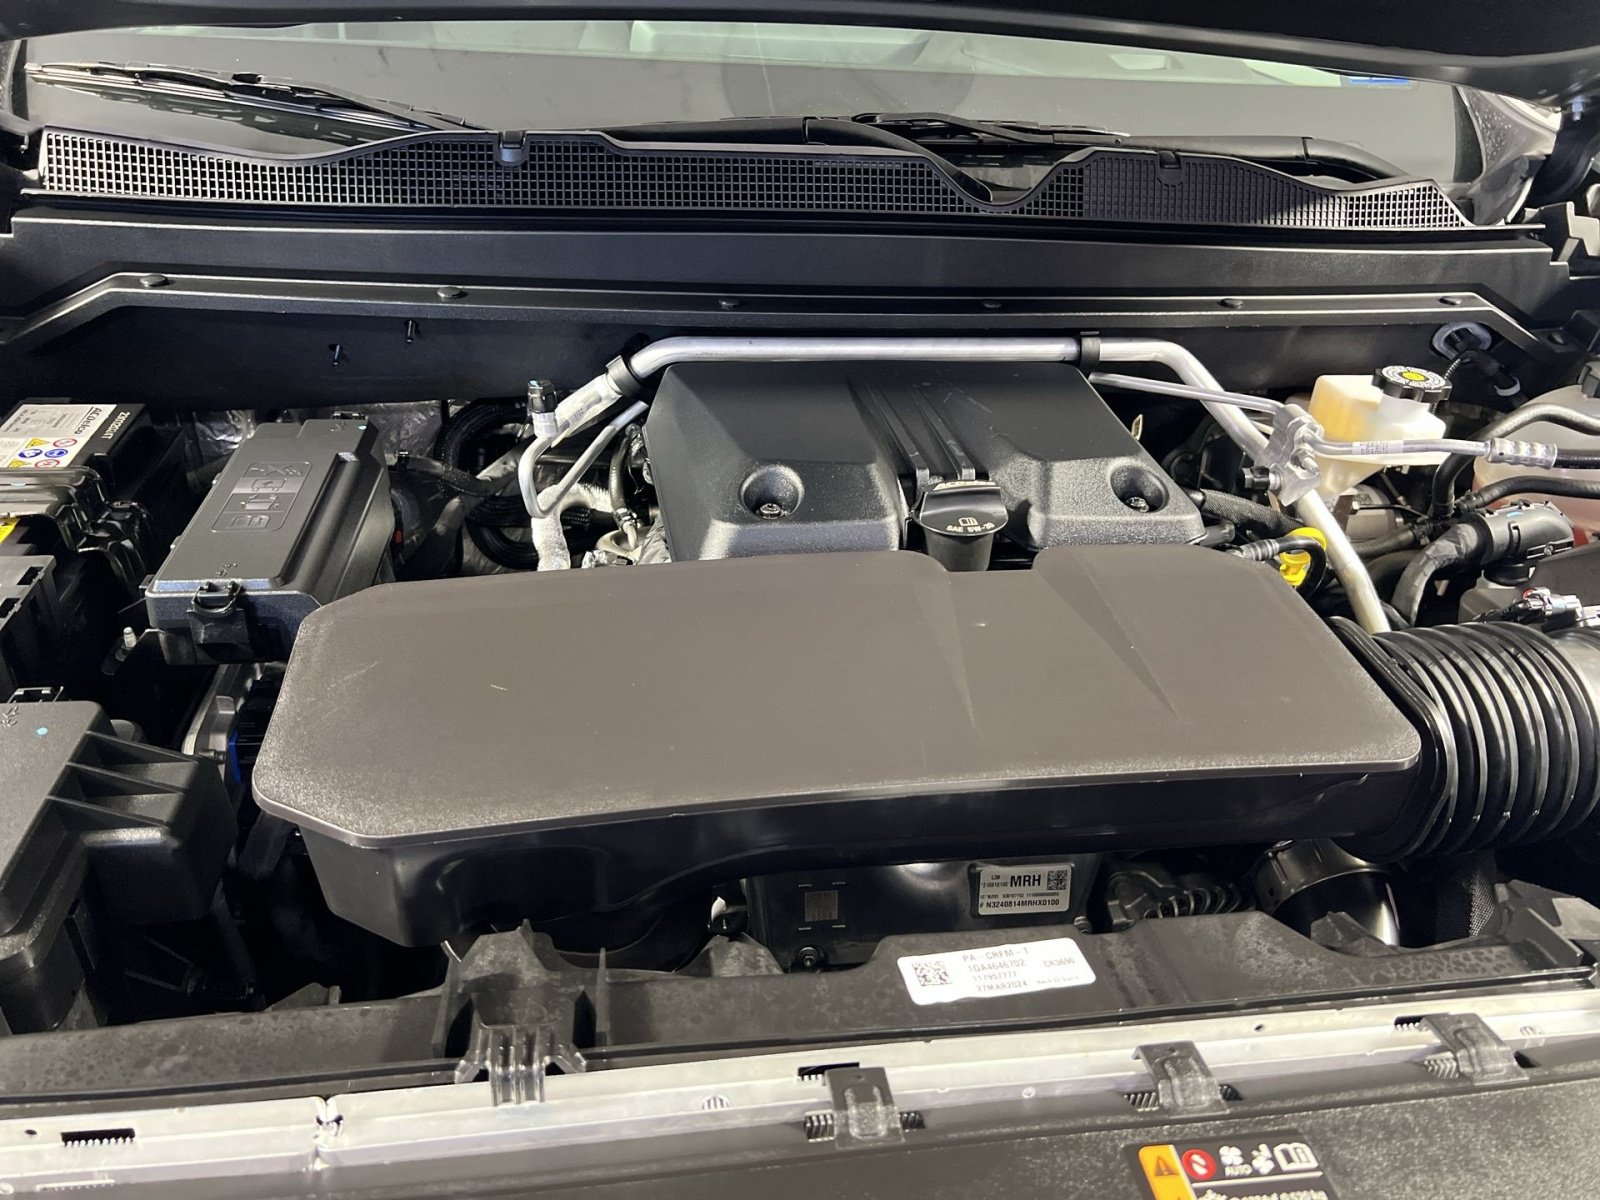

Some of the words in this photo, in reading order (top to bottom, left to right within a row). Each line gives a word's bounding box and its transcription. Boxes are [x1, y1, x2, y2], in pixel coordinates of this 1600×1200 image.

[74, 406, 102, 435] ACDelco
[946, 525, 964, 533] SAE
[1010, 874, 1042, 888] MRH
[985, 949, 1015, 960] CRFM
[976, 980, 1028, 992] 27MAR2024
[1224, 1163, 1253, 1178] AUTO
